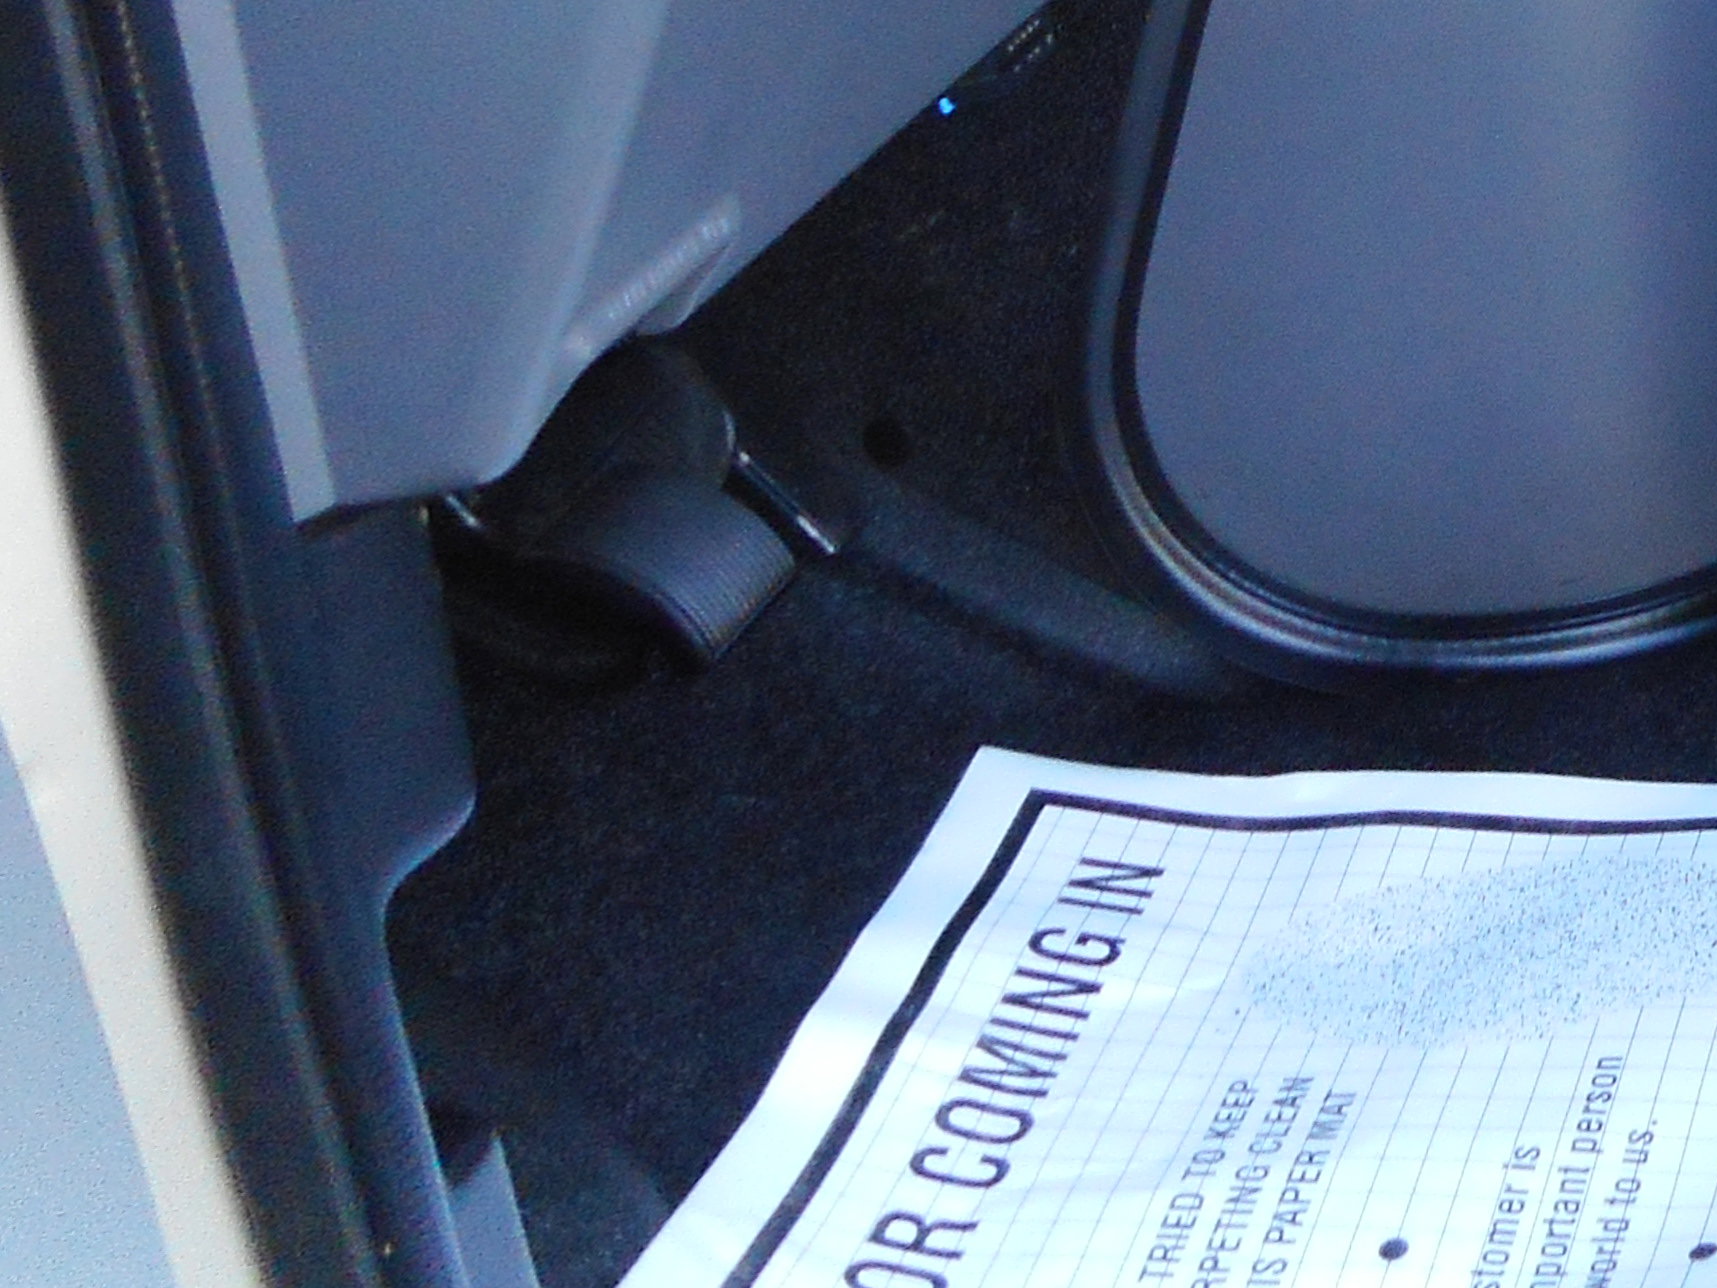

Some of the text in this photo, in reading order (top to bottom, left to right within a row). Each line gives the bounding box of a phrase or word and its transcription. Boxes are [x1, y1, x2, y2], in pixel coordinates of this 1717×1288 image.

[909, 926, 1126, 1190] COMING
[1057, 858, 1165, 917] IN
[1248, 1074, 1315, 1155] CLEAN
[1572, 1055, 1624, 1154] person
[1139, 1078, 1257, 1282] TRIED TO KEEP
[1264, 1149, 1330, 1245] PAPER
[1309, 1087, 1358, 1146] MAT
[1502, 1142, 1541, 1172] is
[1604, 1176, 1643, 1206] to
